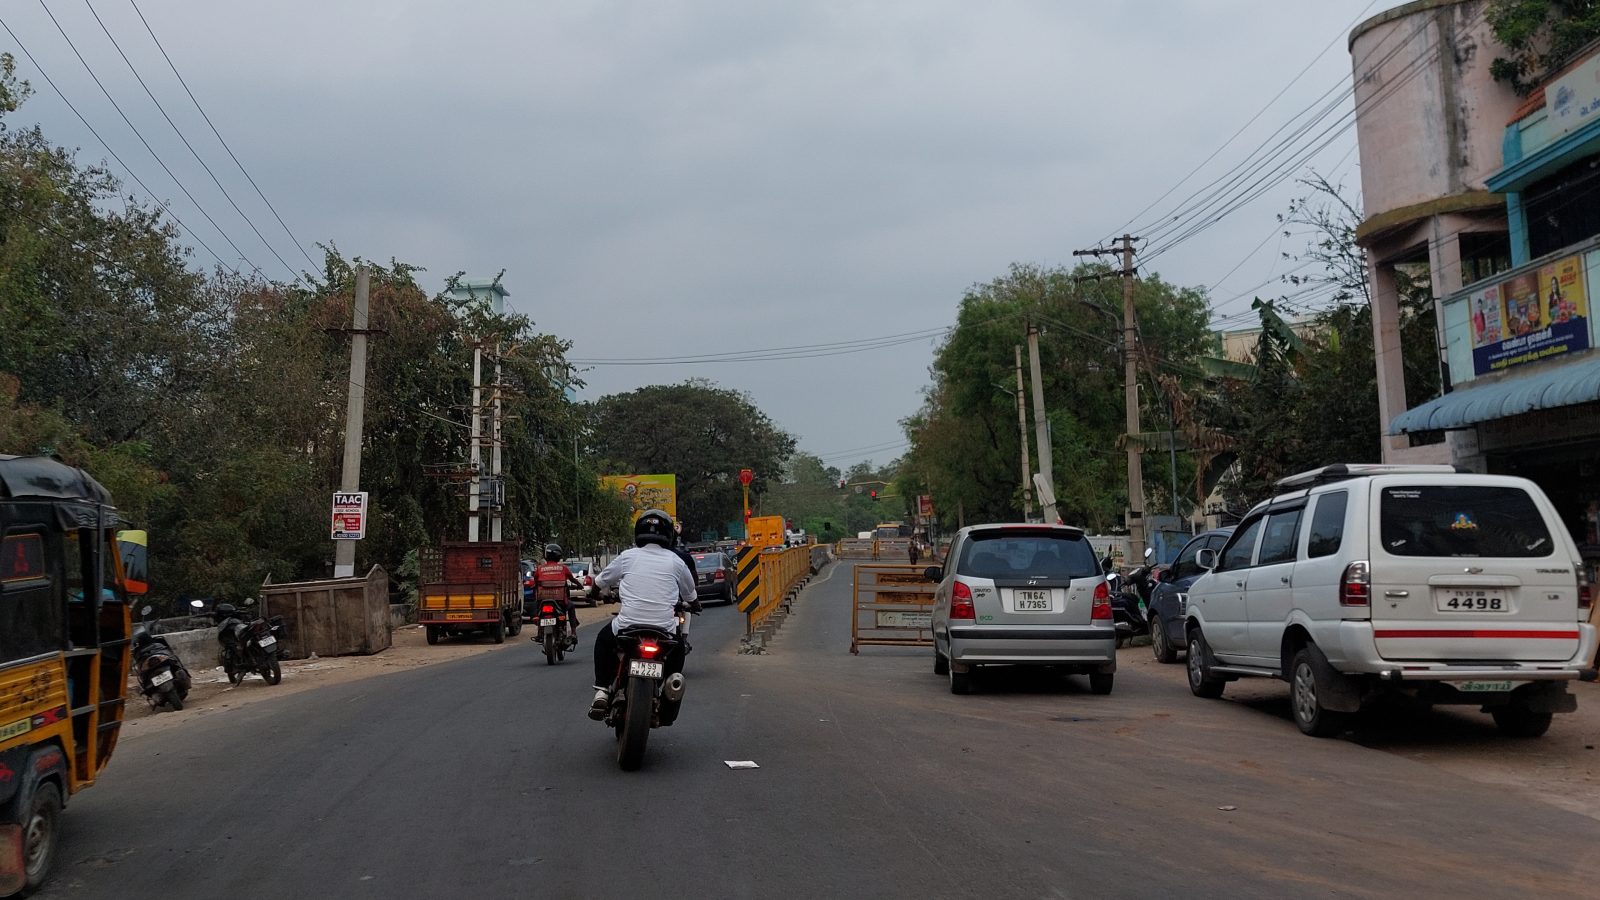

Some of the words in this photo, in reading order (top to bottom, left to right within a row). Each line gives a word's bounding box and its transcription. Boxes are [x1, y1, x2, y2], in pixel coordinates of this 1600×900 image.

[336, 495, 361, 504] TAAC
[1023, 591, 1033, 600] TN
[1034, 591, 1044, 600] 64
[1020, 601, 1025, 609] H
[1027, 601, 1047, 609] 7365
[1447, 598, 1502, 609] 4498
